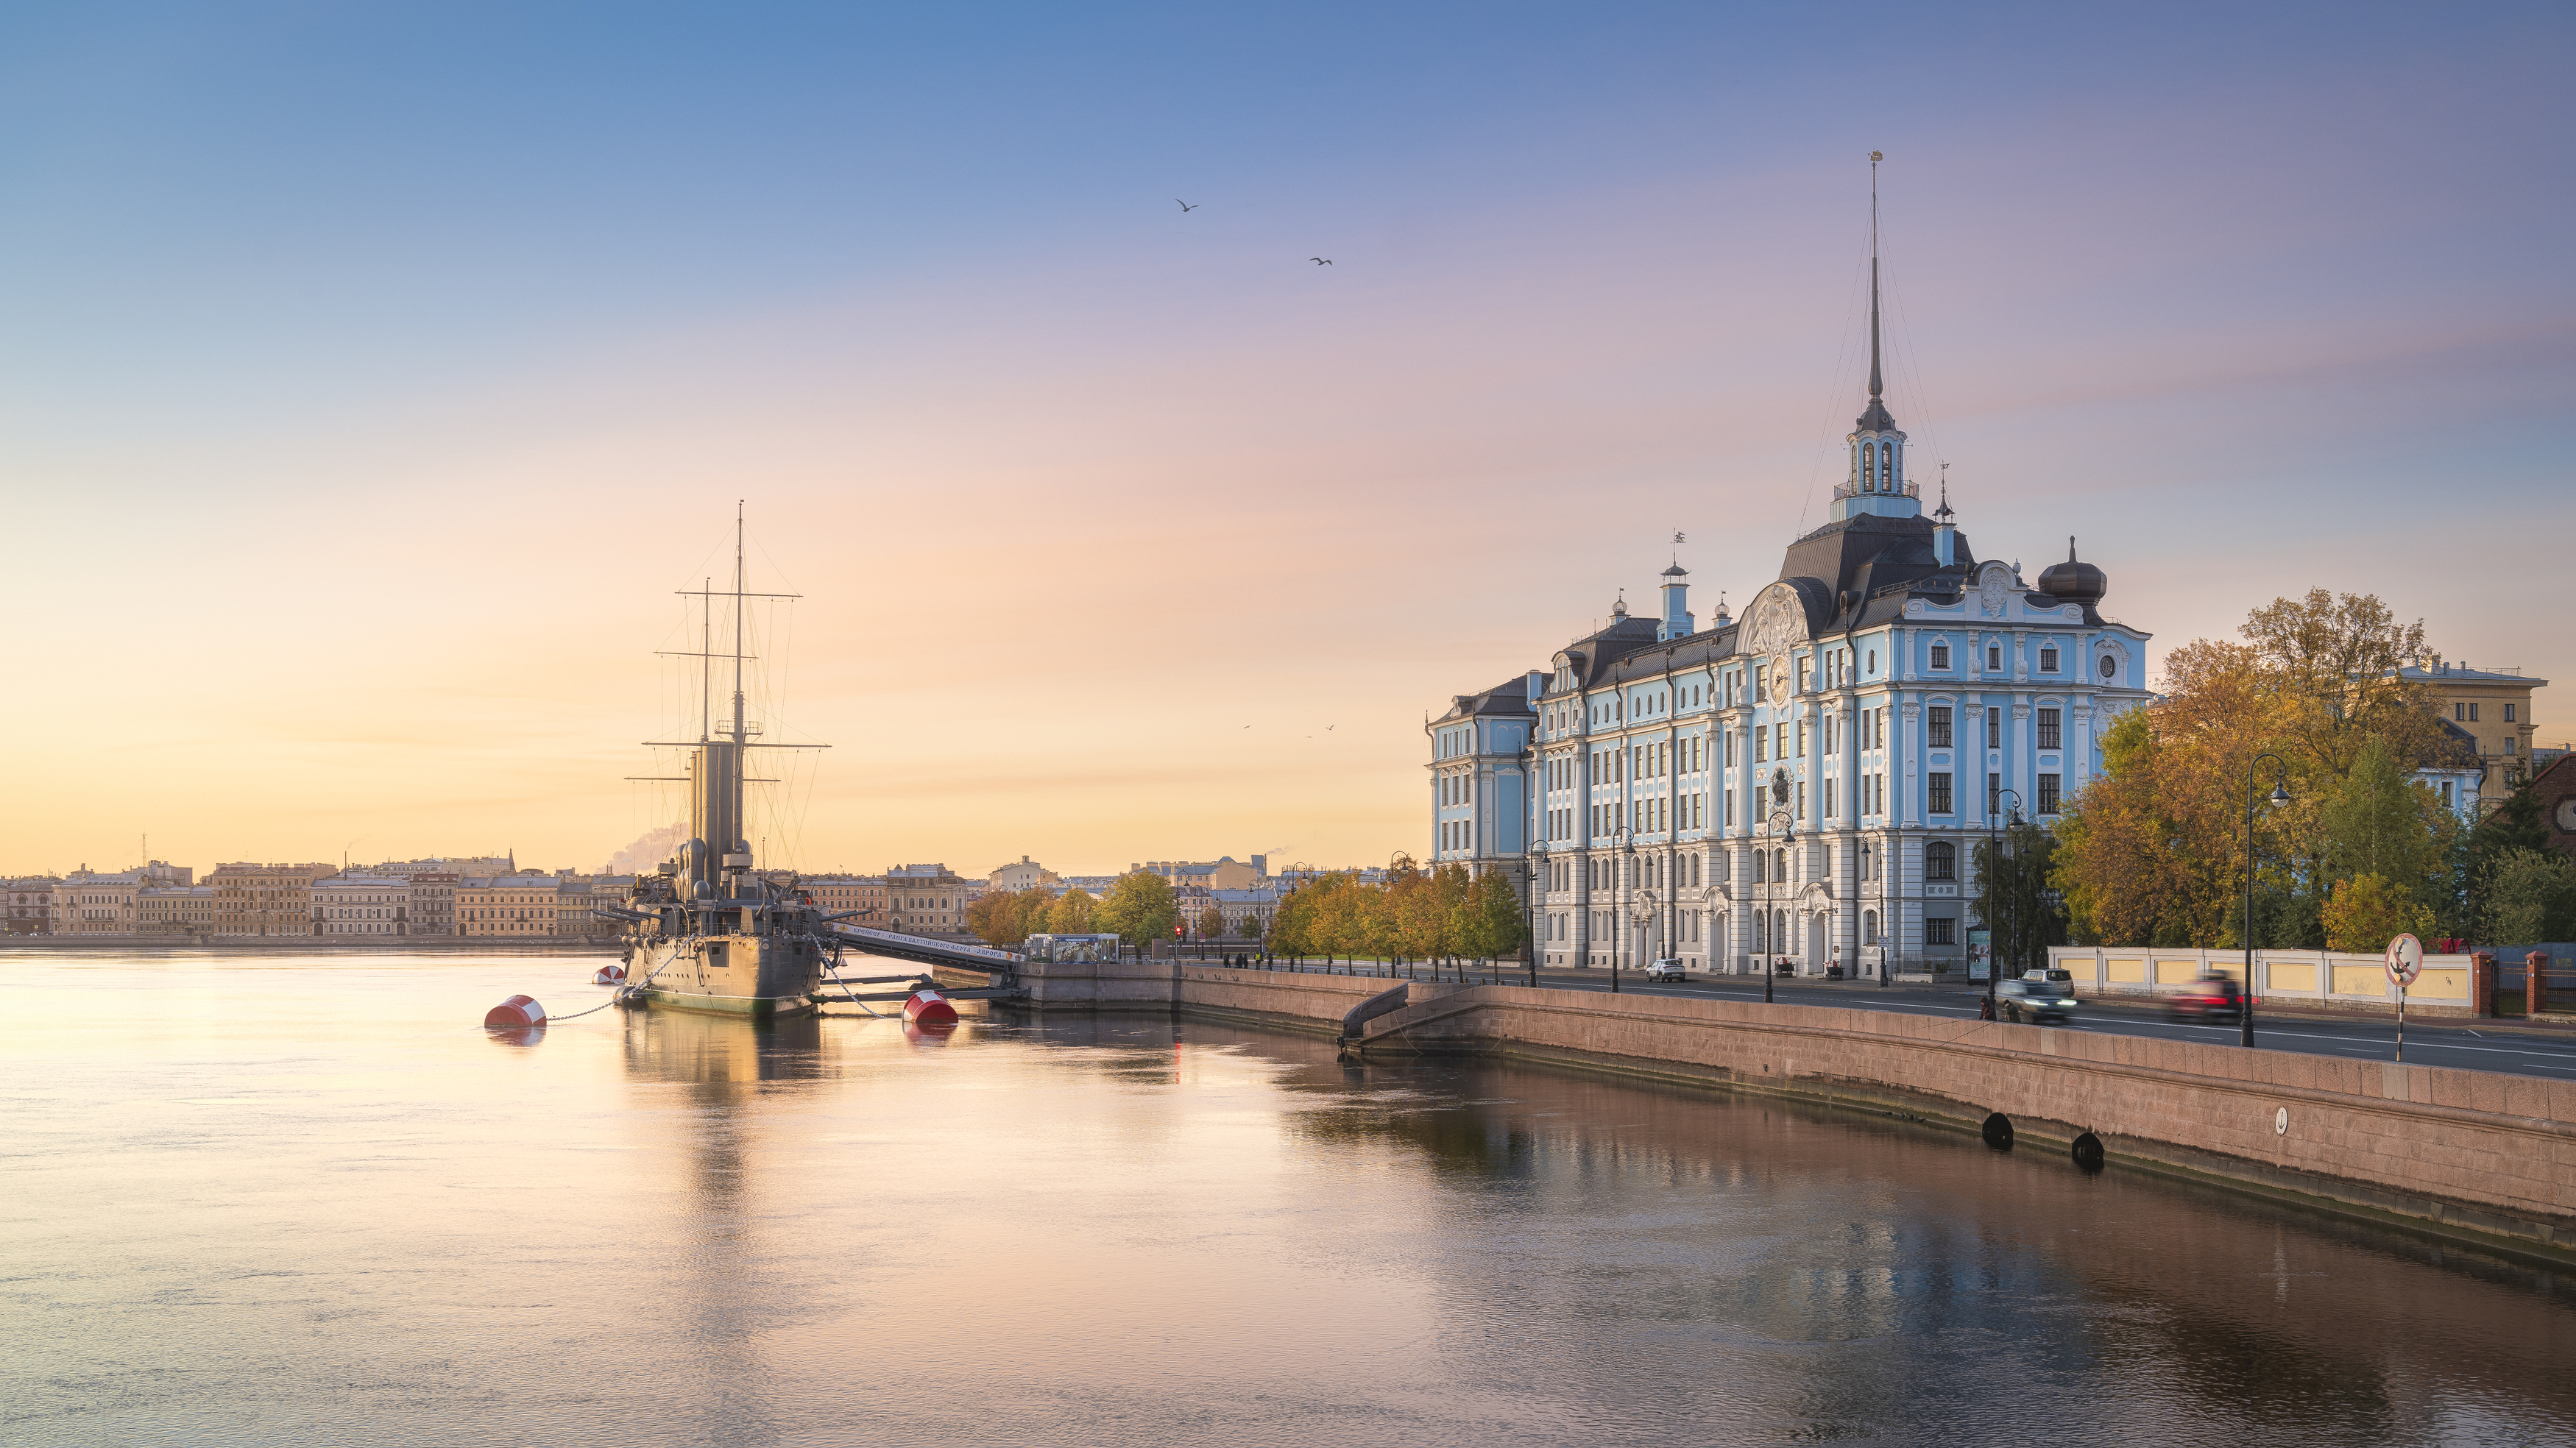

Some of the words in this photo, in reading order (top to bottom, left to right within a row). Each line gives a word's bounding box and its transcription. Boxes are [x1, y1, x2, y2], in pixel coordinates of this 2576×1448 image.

[888, 934, 907, 942] РАНГА
[908, 938, 949, 948] БАЛТИЙСКОГО
[950, 945, 971, 953] ФЛОТА
